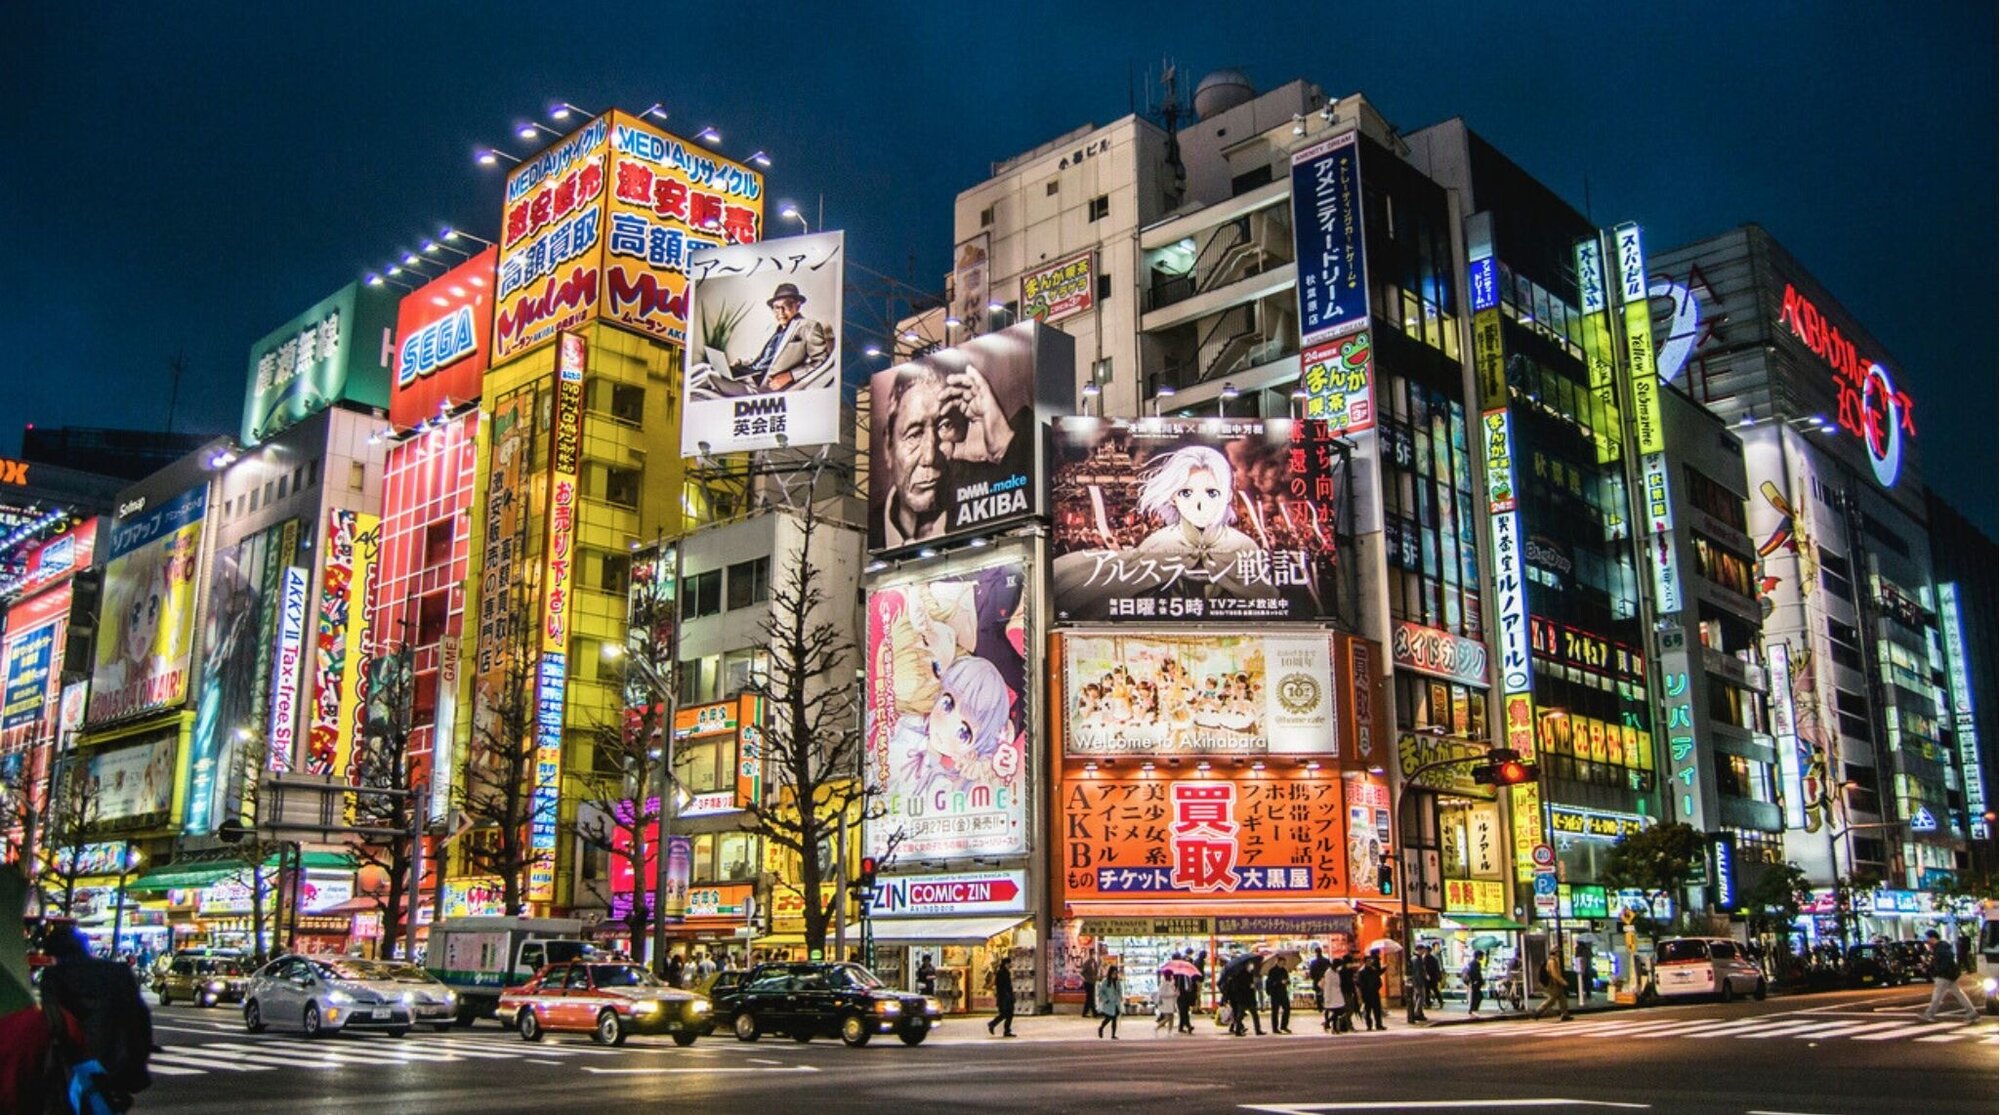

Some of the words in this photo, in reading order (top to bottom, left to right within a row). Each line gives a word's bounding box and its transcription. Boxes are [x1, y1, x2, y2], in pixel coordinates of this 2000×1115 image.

[618, 126, 759, 198] MEDIAリサイクル
[506, 157, 603, 246] 激安販売
[616, 161, 756, 244] 激安販売
[500, 209, 597, 301] 高額買取
[400, 302, 476, 389] SEGA
[1630, 333, 1645, 373] Yellow
[734, 397, 786, 417] DMM
[1306, 364, 1367, 394] まんが
[733, 415, 786, 436] 英会話
[1635, 381, 1653, 446] Submarine
[112, 513, 162, 550] ソフマップ
[956, 489, 1028, 527] AKIBA
[1083, 548, 1309, 592] アルスラーン戦記
[285, 571, 305, 627] AKKY
[1565, 631, 1609, 668] フィギュア
[277, 644, 301, 723] Tax-free
[1074, 733, 1152, 749] Welcome
[1155, 734, 1173, 749] to
[1180, 732, 1267, 750] Akihabara
[934, 782, 1018, 813] GAME!
[1097, 783, 1119, 864] アイドル
[1120, 784, 1142, 841] アニメ
[1144, 783, 1167, 865] 美少女系
[1241, 784, 1264, 865] フィギュア
[1264, 783, 1286, 842] ホビー
[1288, 783, 1313, 865] 携帯電話
[1174, 785, 1237, 888] 買取
[1313, 784, 1339, 890] アップルとか
[872, 878, 907, 913] ZIN
[911, 885, 964, 903] COMIC
[967, 883, 991, 901] ZIN
[1098, 868, 1171, 890] チケット
[1243, 868, 1311, 890] 大黒屋
